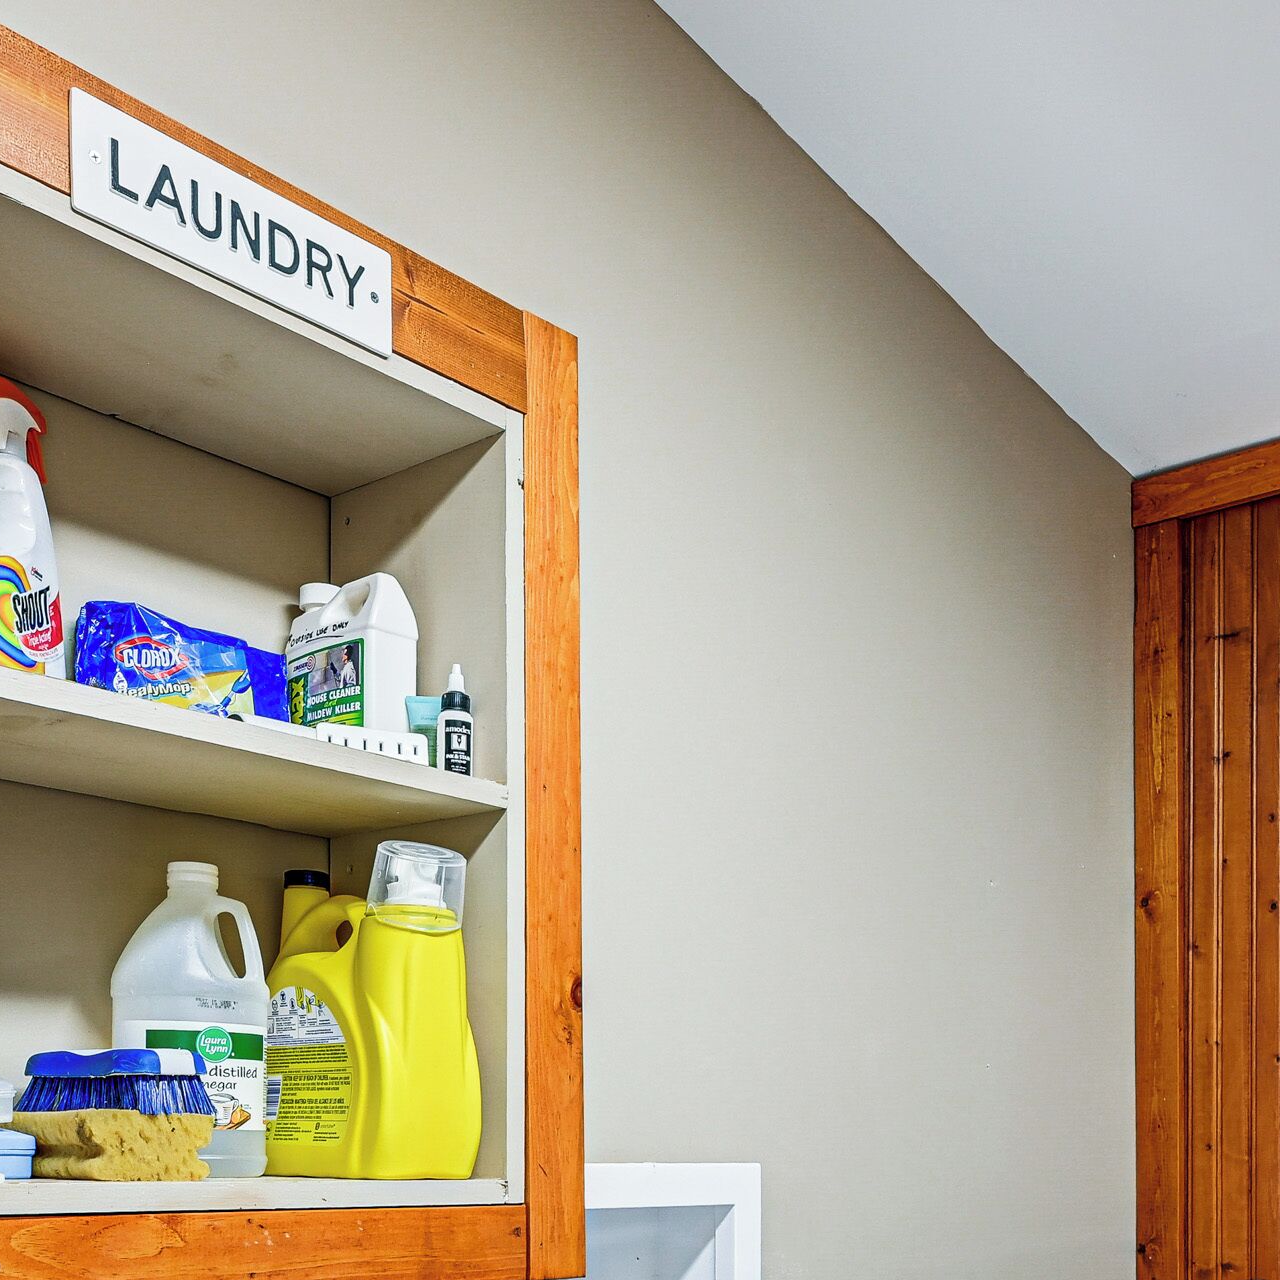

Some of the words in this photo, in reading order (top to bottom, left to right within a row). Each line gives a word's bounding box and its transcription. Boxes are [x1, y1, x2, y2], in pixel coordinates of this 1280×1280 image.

[108, 137, 365, 308] LAUNDRY
[12, 585, 50, 634] SHOUT
[316, 625, 329, 637] USE
[332, 621, 349, 632] ONLY
[123, 647, 181, 668] CLOROX
[329, 686, 361, 701] CLEANER
[307, 707, 333, 722] MILDEW
[335, 701, 361, 715] KILLER
[200, 1035, 227, 1047] Laura
[206, 1044, 228, 1055] Lynn
[209, 1065, 258, 1079] distilled
[203, 1081, 237, 1092] negar
